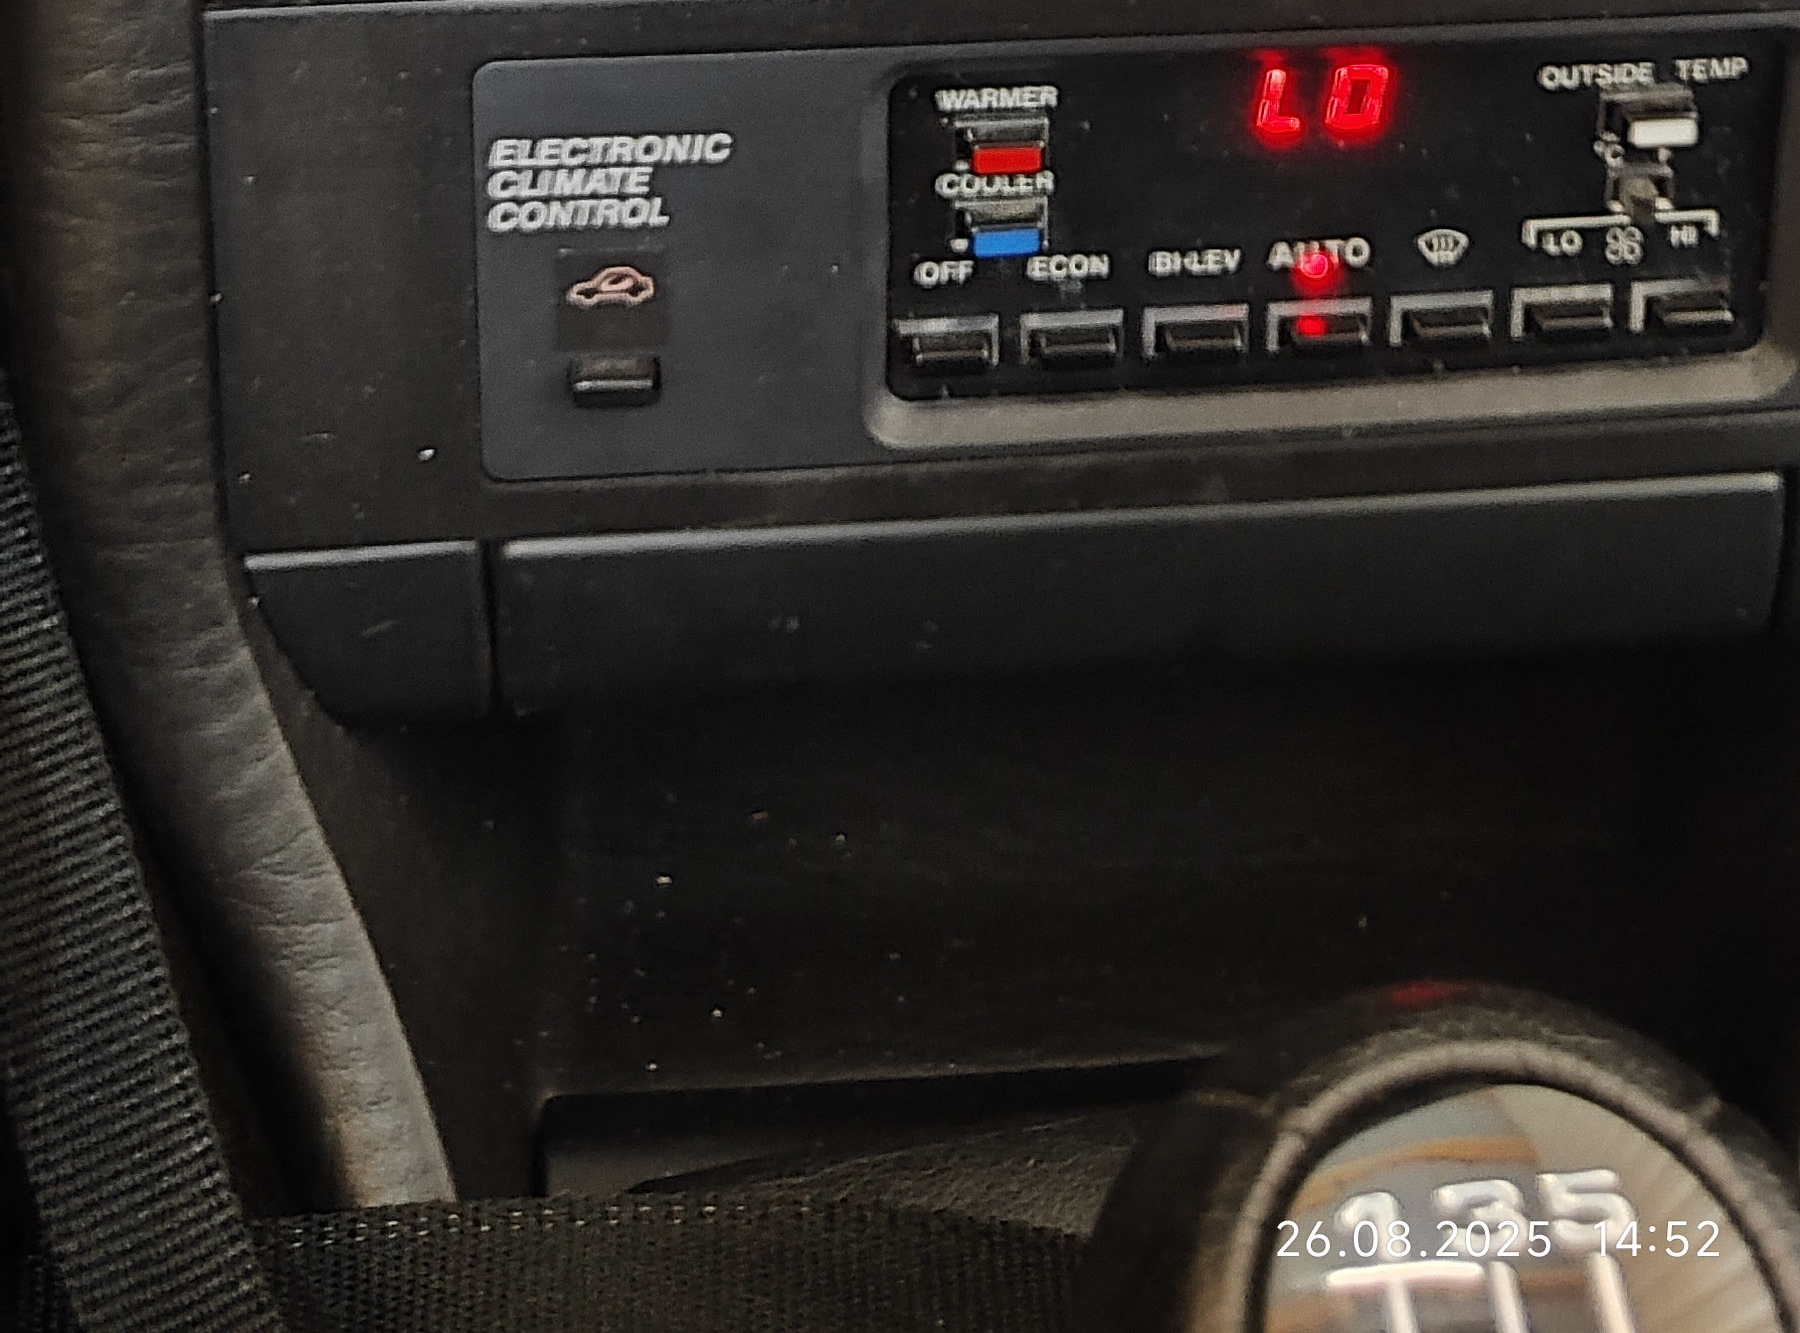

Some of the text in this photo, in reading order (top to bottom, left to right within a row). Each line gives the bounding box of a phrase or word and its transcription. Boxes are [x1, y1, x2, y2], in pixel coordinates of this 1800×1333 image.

[1540, 56, 1750, 90] OUTSIDE TEMP
[935, 86, 1058, 112] WARMER
[489, 134, 733, 169] ELECTRONIC
[488, 167, 654, 200] CLIMATE
[935, 171, 1055, 197] COOLER
[488, 198, 671, 233] CONTROL
[1267, 237, 1371, 270] AUTO
[1543, 229, 1584, 256] LO
[914, 259, 976, 287] OFF
[1027, 255, 1111, 280] ECON
[1537, 1169, 1636, 1253] 5
